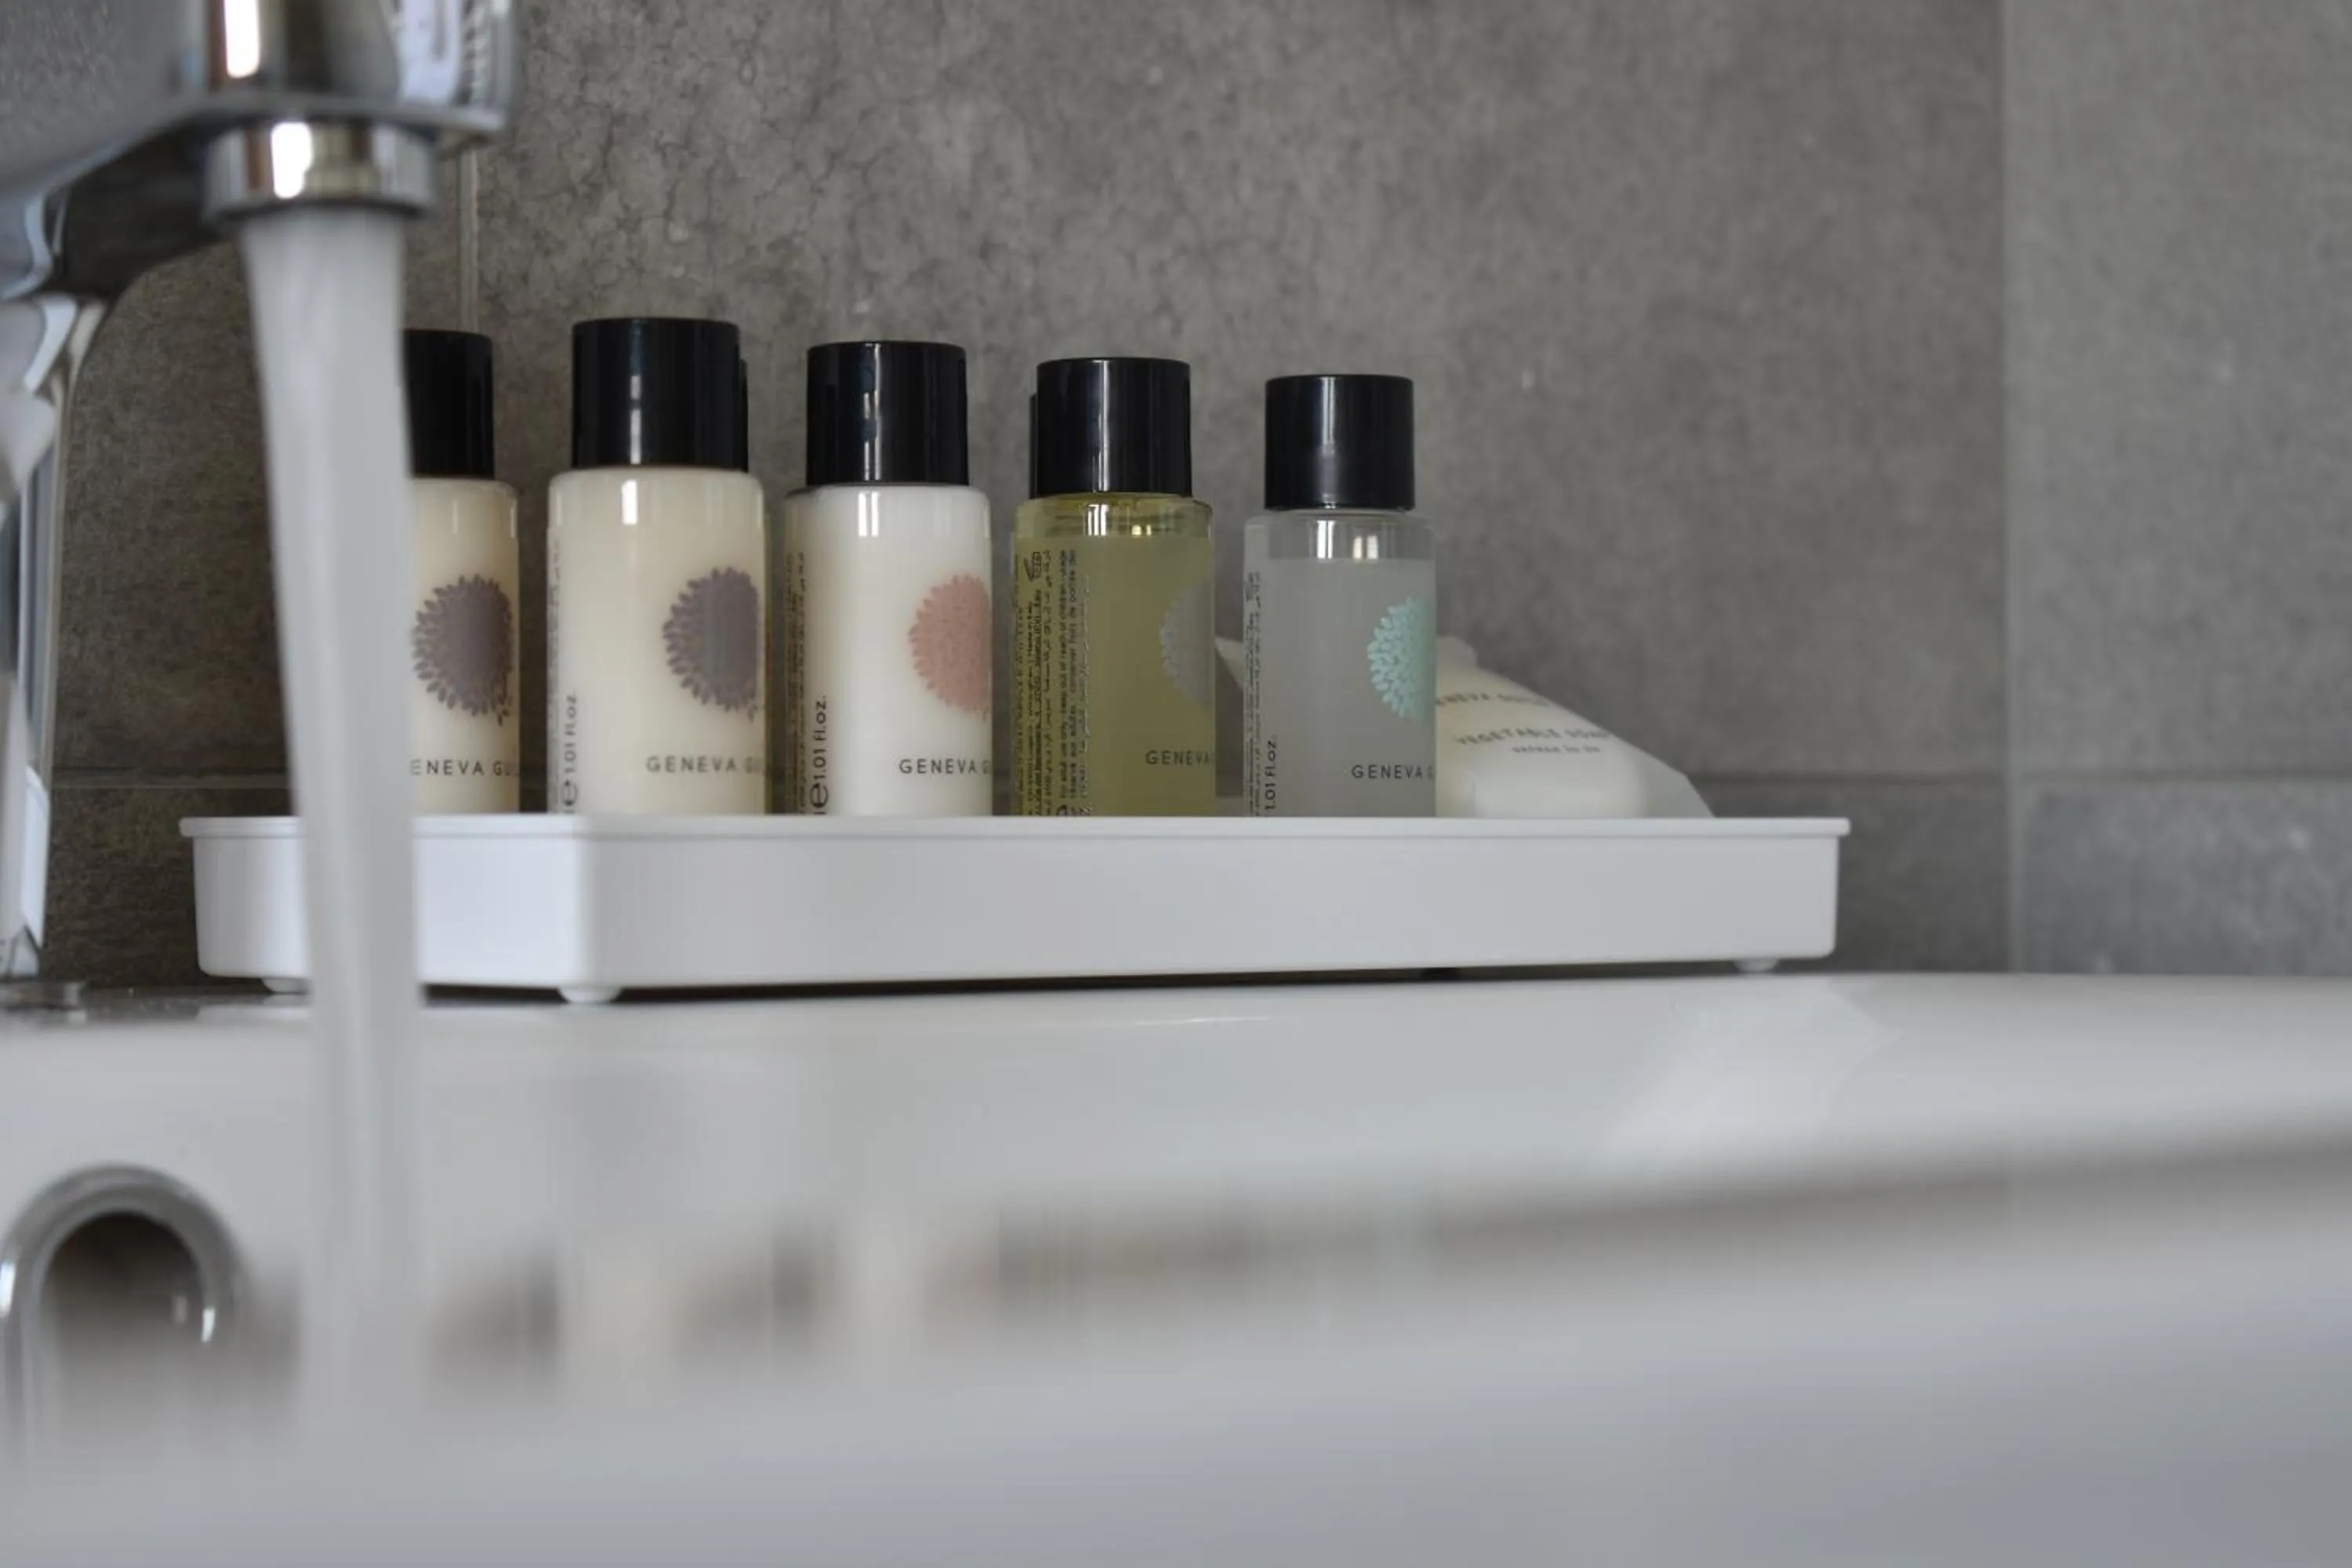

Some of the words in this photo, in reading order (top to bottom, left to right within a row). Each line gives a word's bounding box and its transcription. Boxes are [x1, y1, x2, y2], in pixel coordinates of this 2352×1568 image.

[409, 758, 485, 776] ENEVA
[645, 755, 737, 774] GENEVA
[812, 749, 826, 781] 1.01
[899, 757, 978, 775] GENEVA
[1145, 750, 1210, 766] GENEVA
[1351, 764, 1423, 779] GENEVA
